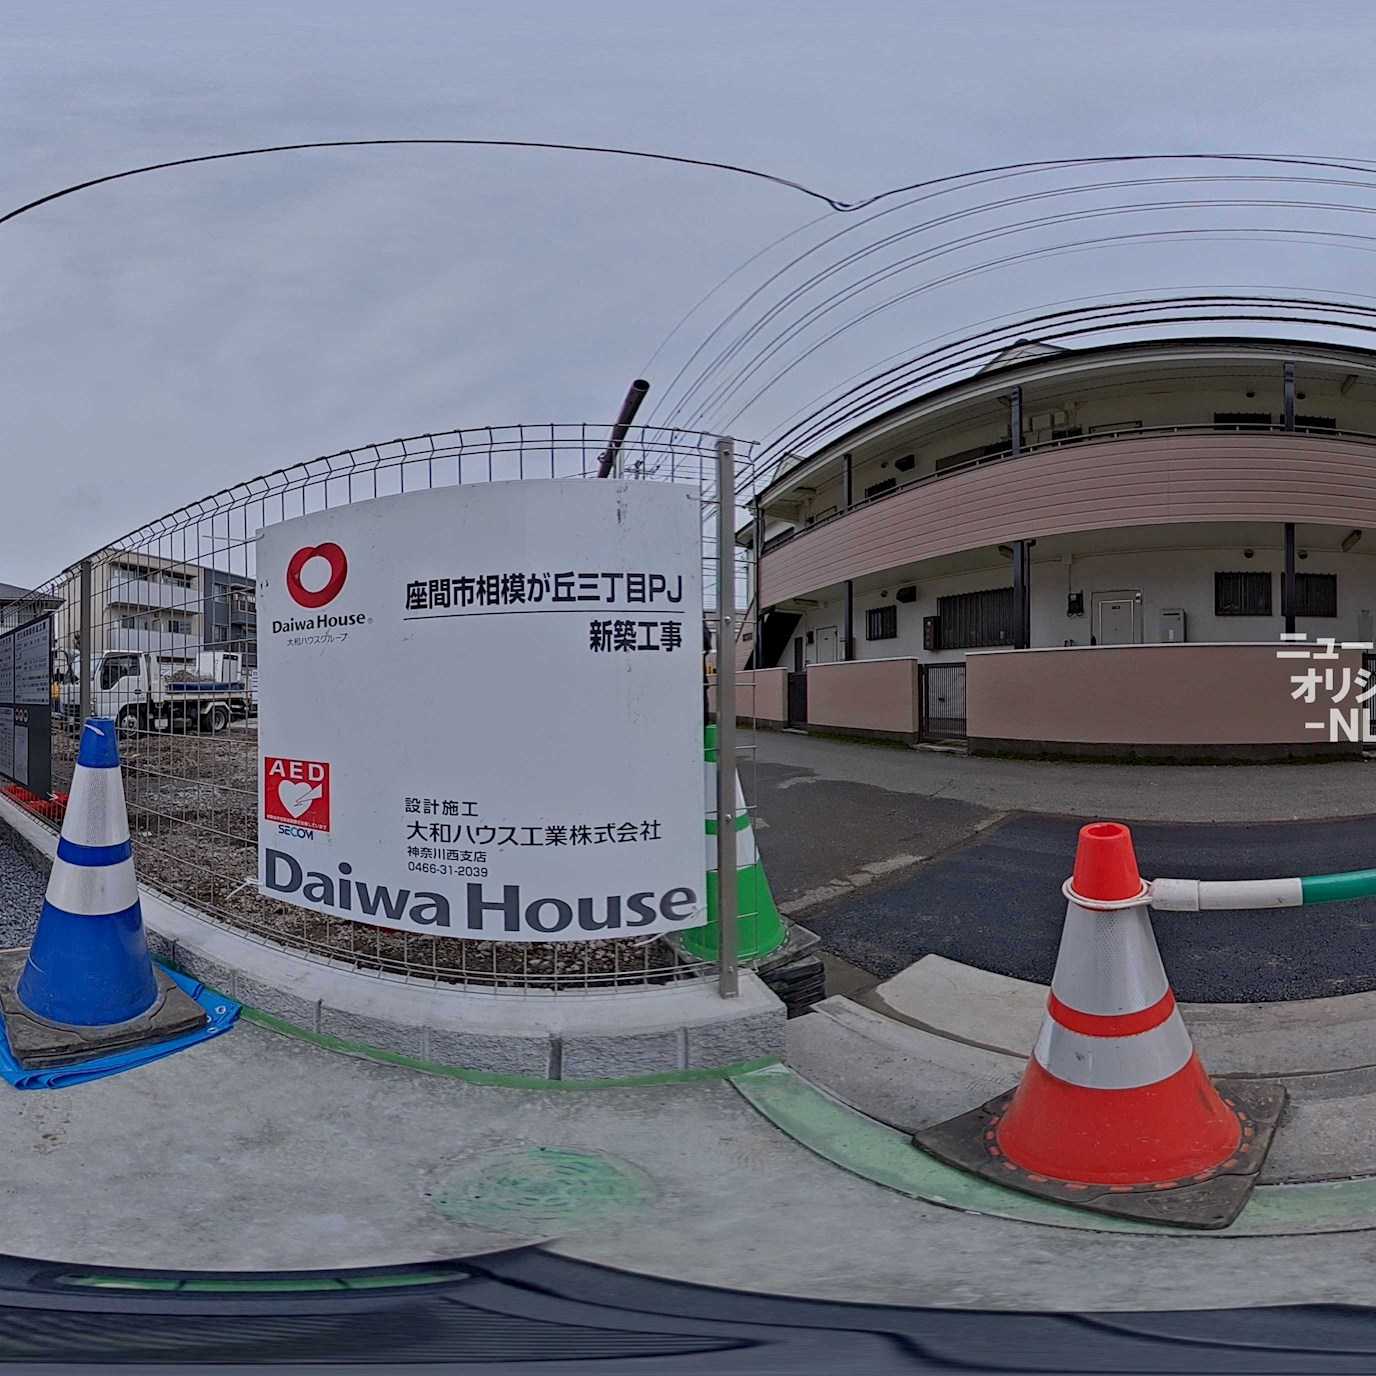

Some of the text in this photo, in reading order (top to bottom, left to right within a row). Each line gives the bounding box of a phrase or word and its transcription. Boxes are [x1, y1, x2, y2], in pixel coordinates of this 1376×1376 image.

[405, 571, 683, 610] 座間市相模が丘三丁目PJ
[272, 613, 366, 634] Daiwa House
[287, 632, 348, 647] 大和ハウスグループ
[589, 619, 682, 652] 新築工事
[268, 760, 325, 782] AED
[404, 797, 479, 817] 設計施工
[278, 824, 314, 840] SECOM
[407, 820, 662, 847] 大和ハウス工業株式会社
[407, 846, 488, 863] 神奈川西支店
[407, 861, 488, 878] 0466-31-2039
[265, 848, 697, 932] Daiwa House
